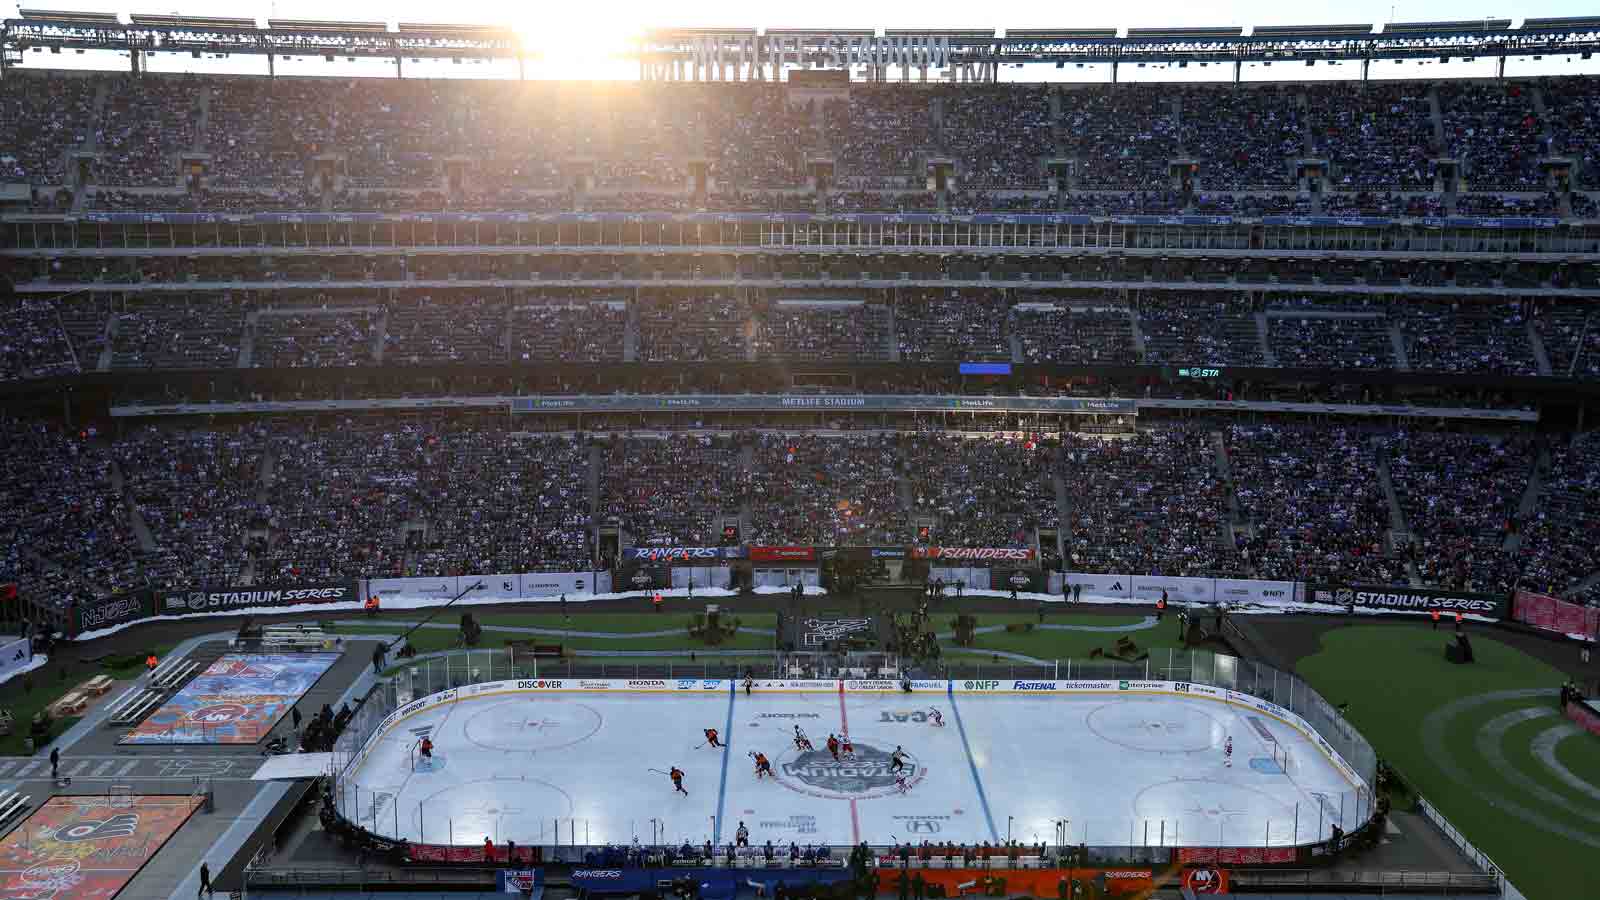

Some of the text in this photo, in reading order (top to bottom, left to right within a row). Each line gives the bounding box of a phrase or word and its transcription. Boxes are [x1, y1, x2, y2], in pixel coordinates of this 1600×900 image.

[823, 36, 950, 68] STADIUM
[1201, 369, 1219, 377] STA
[782, 397, 865, 406] METLIFE STADIUM
[962, 399, 993, 407] MetLife
[1087, 401, 1120, 409] MetLife
[634, 546, 716, 559] RANGERS
[936, 546, 1030, 560] ISLANDERS
[208, 587, 347, 607] STADIUM SERIES
[1354, 591, 1497, 611] STADIUM SERIES
[518, 680, 562, 689] DISCOVER
[976, 681, 999, 690] NFP
[1013, 681, 1056, 690] FASTENAL
[1066, 681, 1112, 690] ticketmaster
[1175, 682, 1190, 692] CAT
[402, 701, 425, 716] verizon
[572, 870, 622, 879] RANGERS
